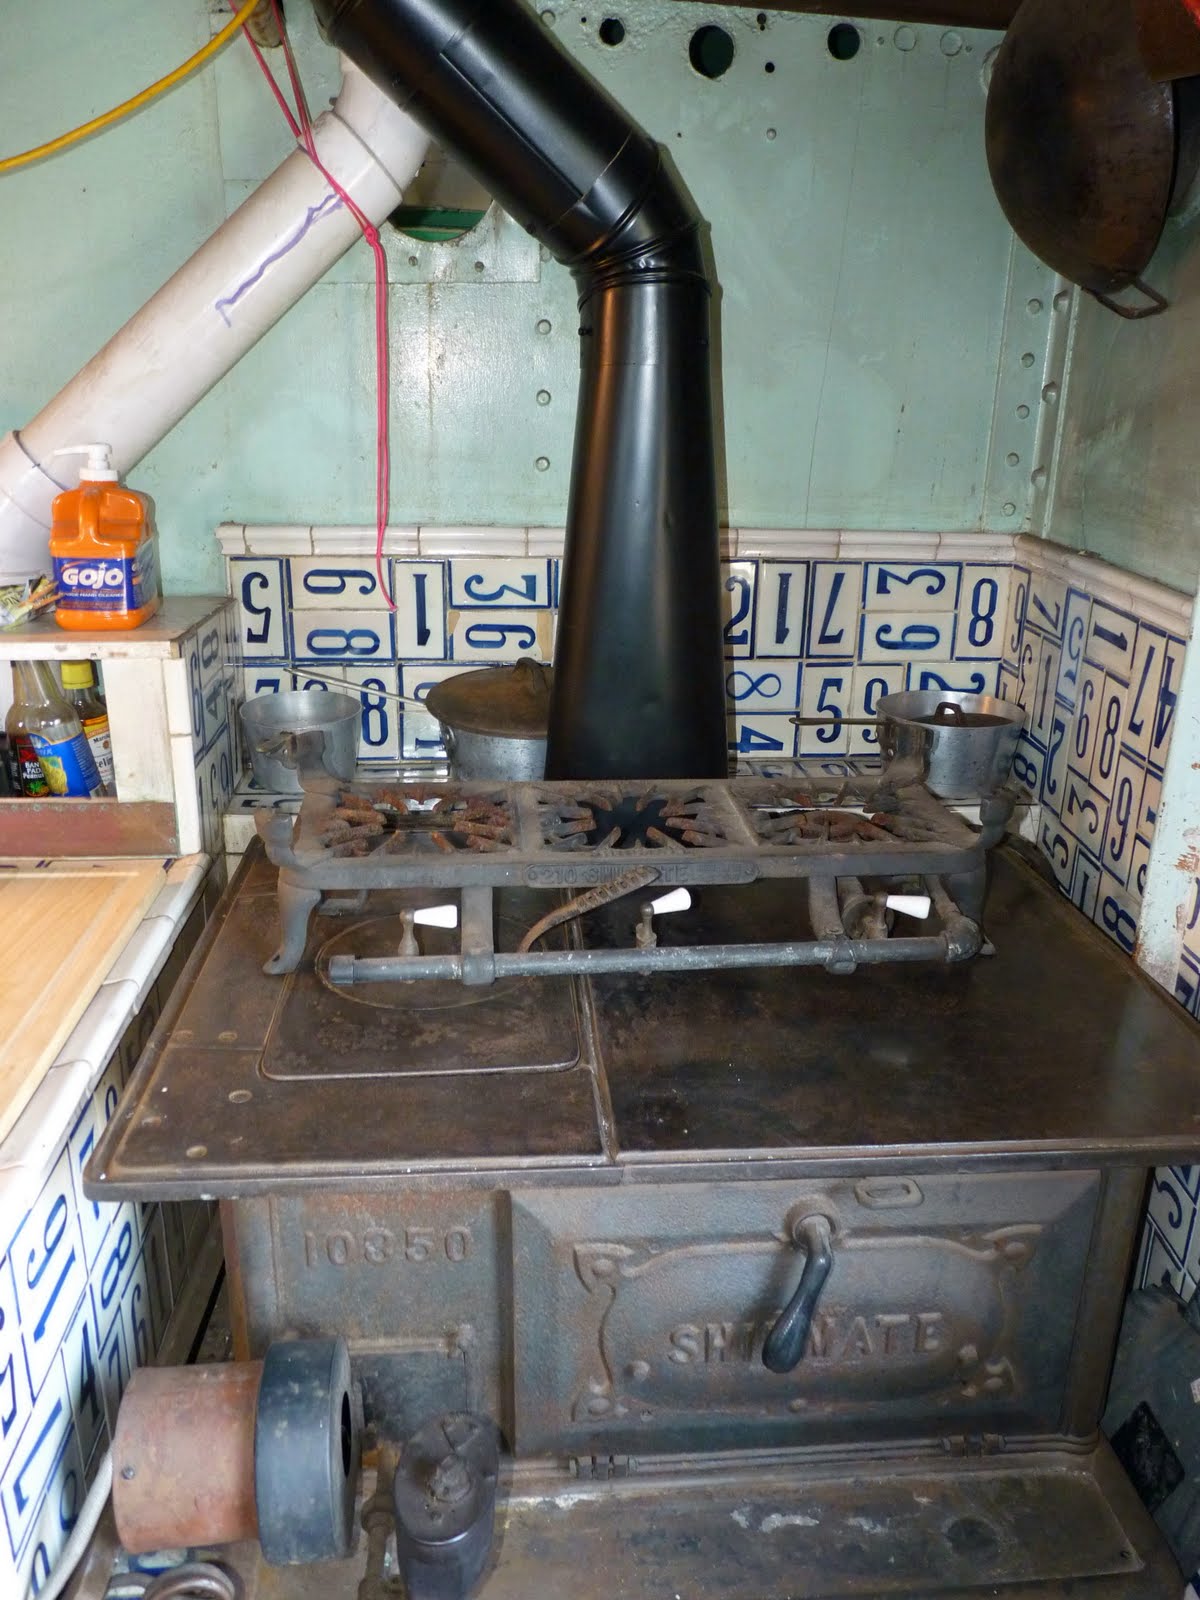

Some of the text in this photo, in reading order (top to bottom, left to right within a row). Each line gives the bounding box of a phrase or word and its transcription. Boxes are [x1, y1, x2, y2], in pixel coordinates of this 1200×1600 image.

[241, 572, 271, 643] 5
[968, 577, 998, 647] 8
[360, 678, 389, 747] 8
[815, 678, 843, 743] 5
[668, 1311, 945, 1364] SHIMATE
